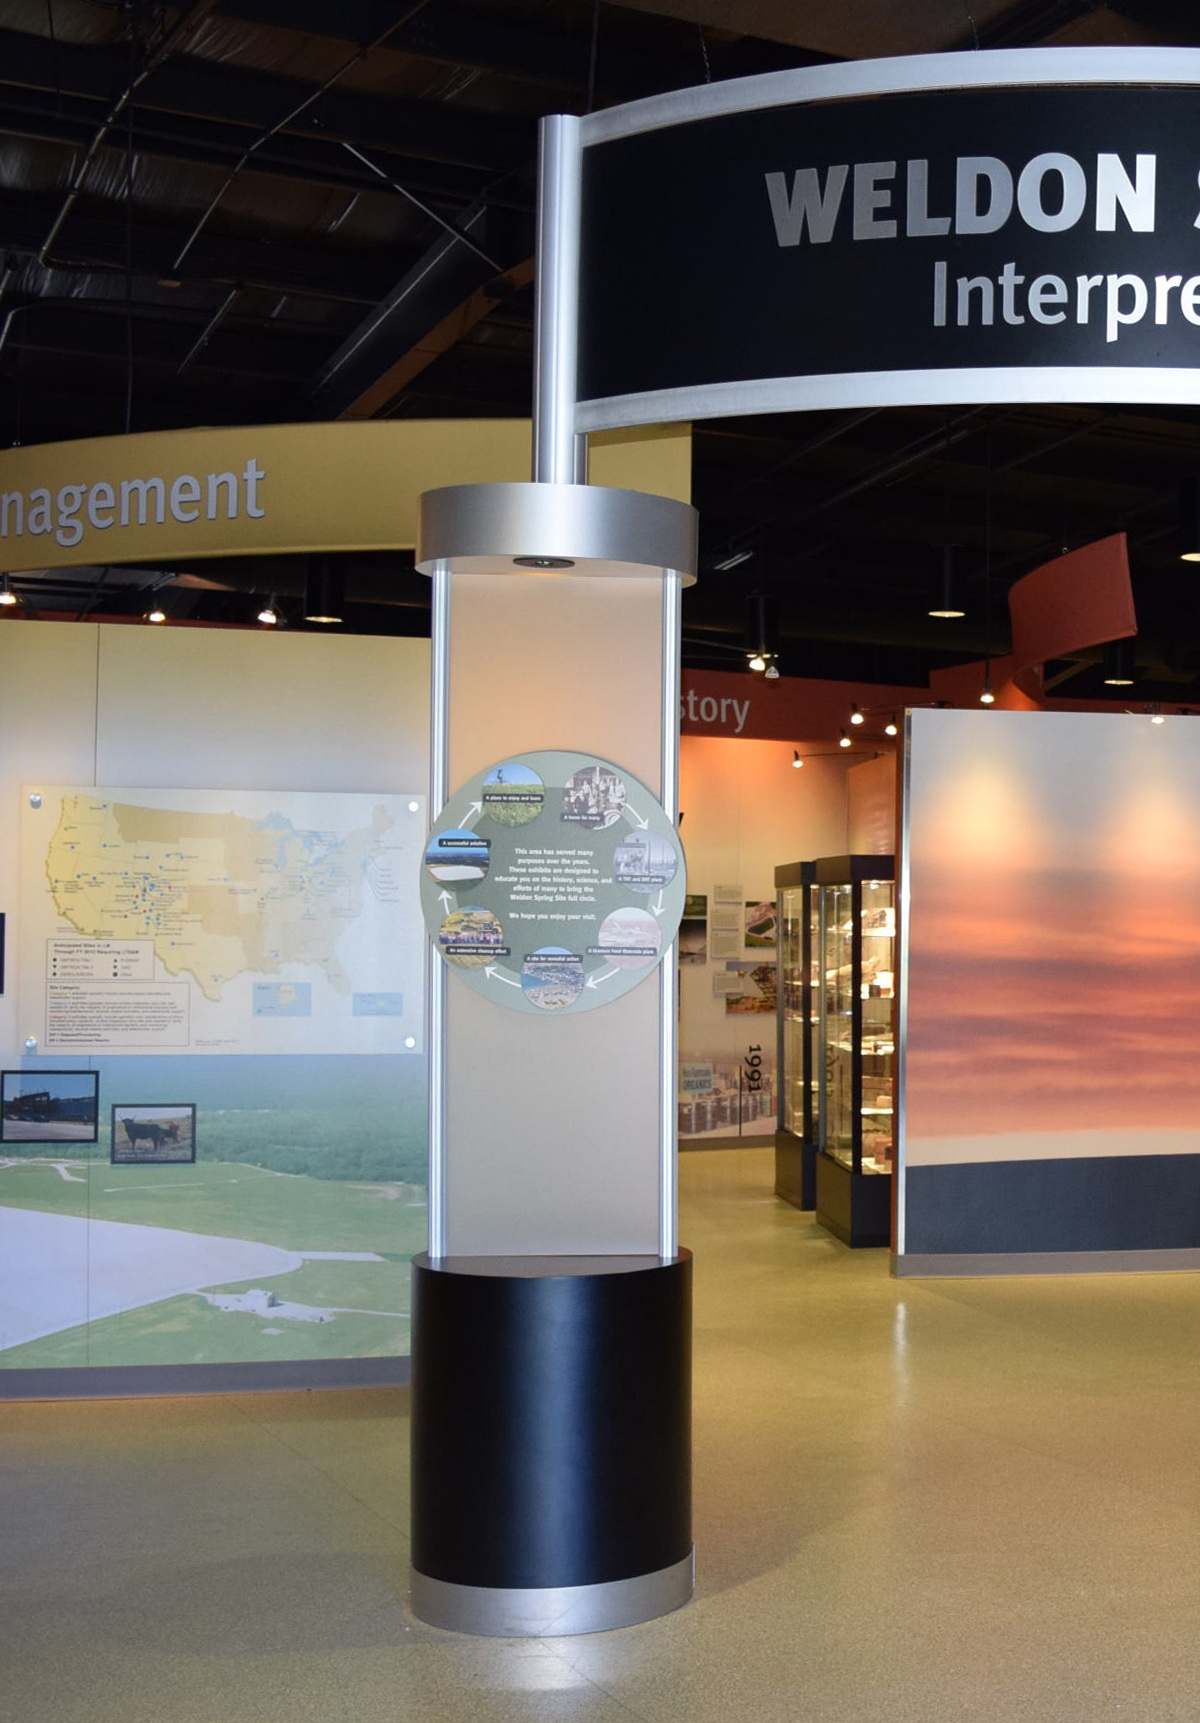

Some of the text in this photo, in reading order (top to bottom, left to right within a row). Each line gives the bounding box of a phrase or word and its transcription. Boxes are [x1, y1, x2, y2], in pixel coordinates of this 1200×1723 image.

[765, 153, 1156, 247] WELDON
[1, 458, 265, 547] nagement
[744, 1044, 762, 1093] 1991
